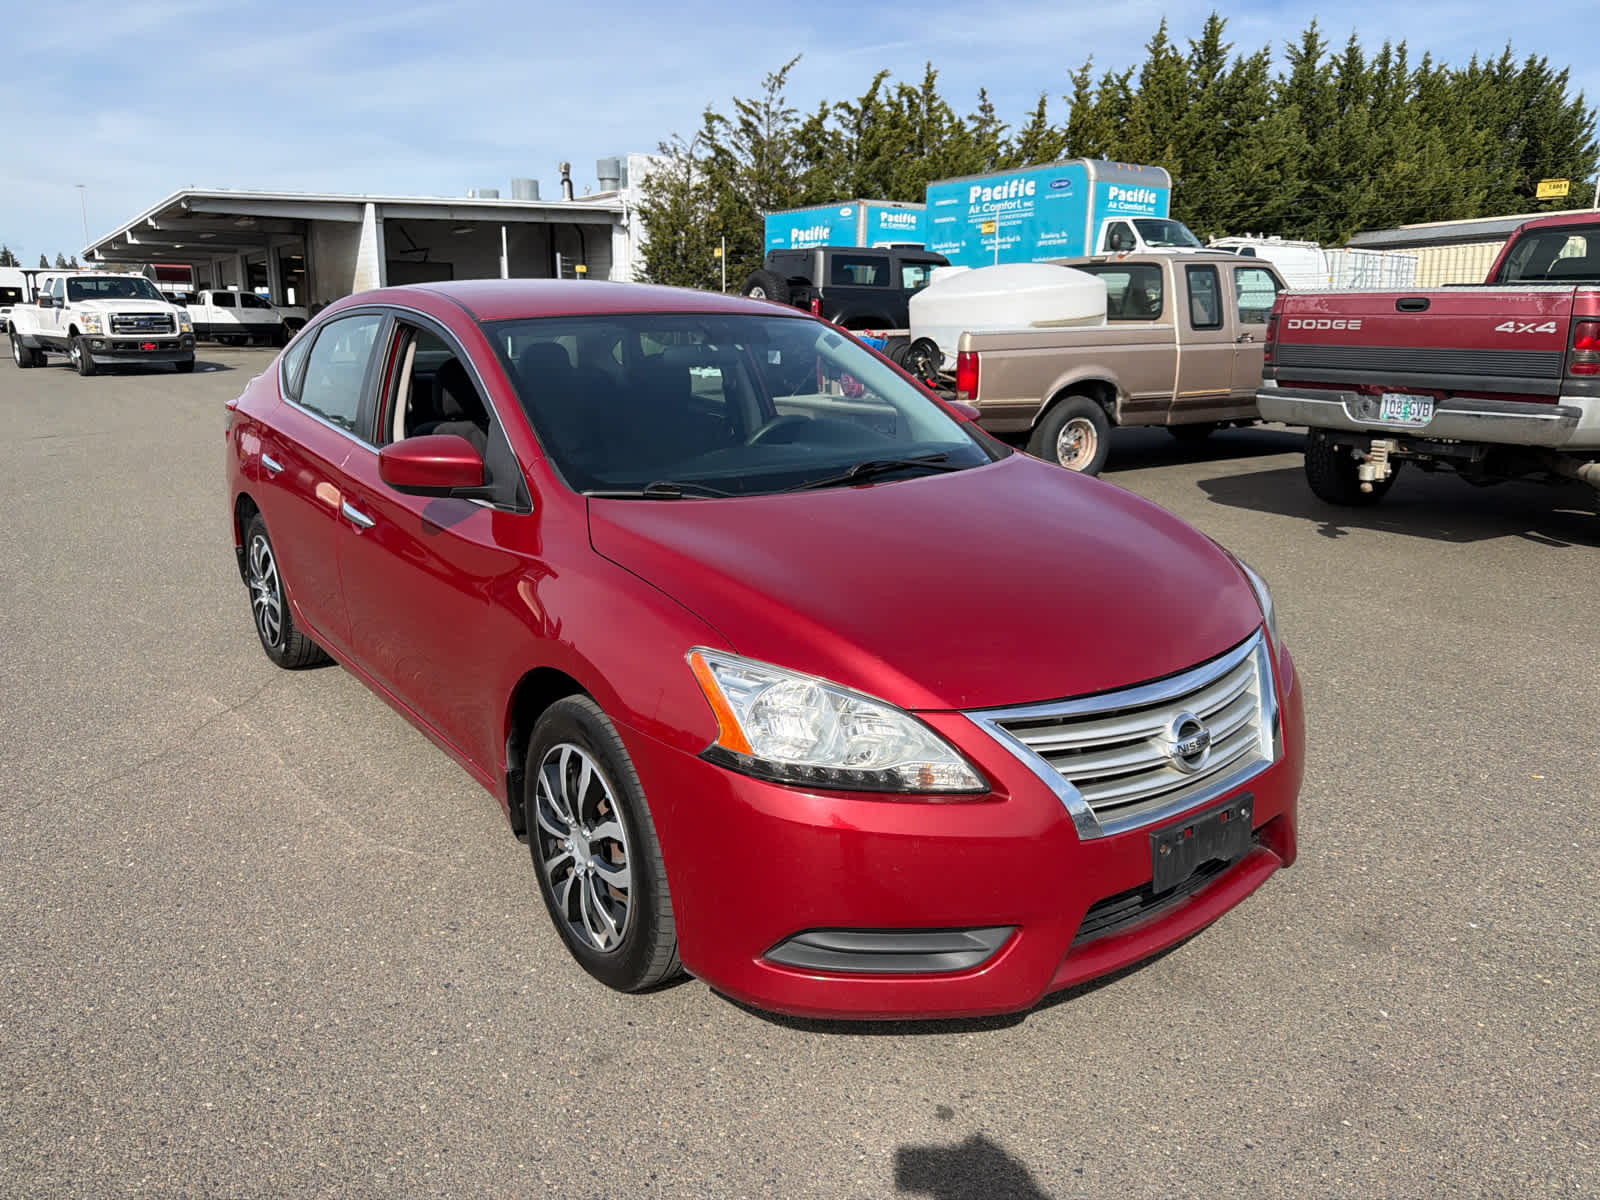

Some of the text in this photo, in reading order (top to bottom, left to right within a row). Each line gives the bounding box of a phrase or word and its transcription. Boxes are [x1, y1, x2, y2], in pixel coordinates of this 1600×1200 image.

[969, 178, 1035, 203] Pacific
[1108, 186, 1156, 204] Pacific
[880, 211, 917, 224] Pacific
[968, 205, 980, 215] Air
[791, 225, 830, 242] Pacific
[1288, 319, 1362, 330] DODGE
